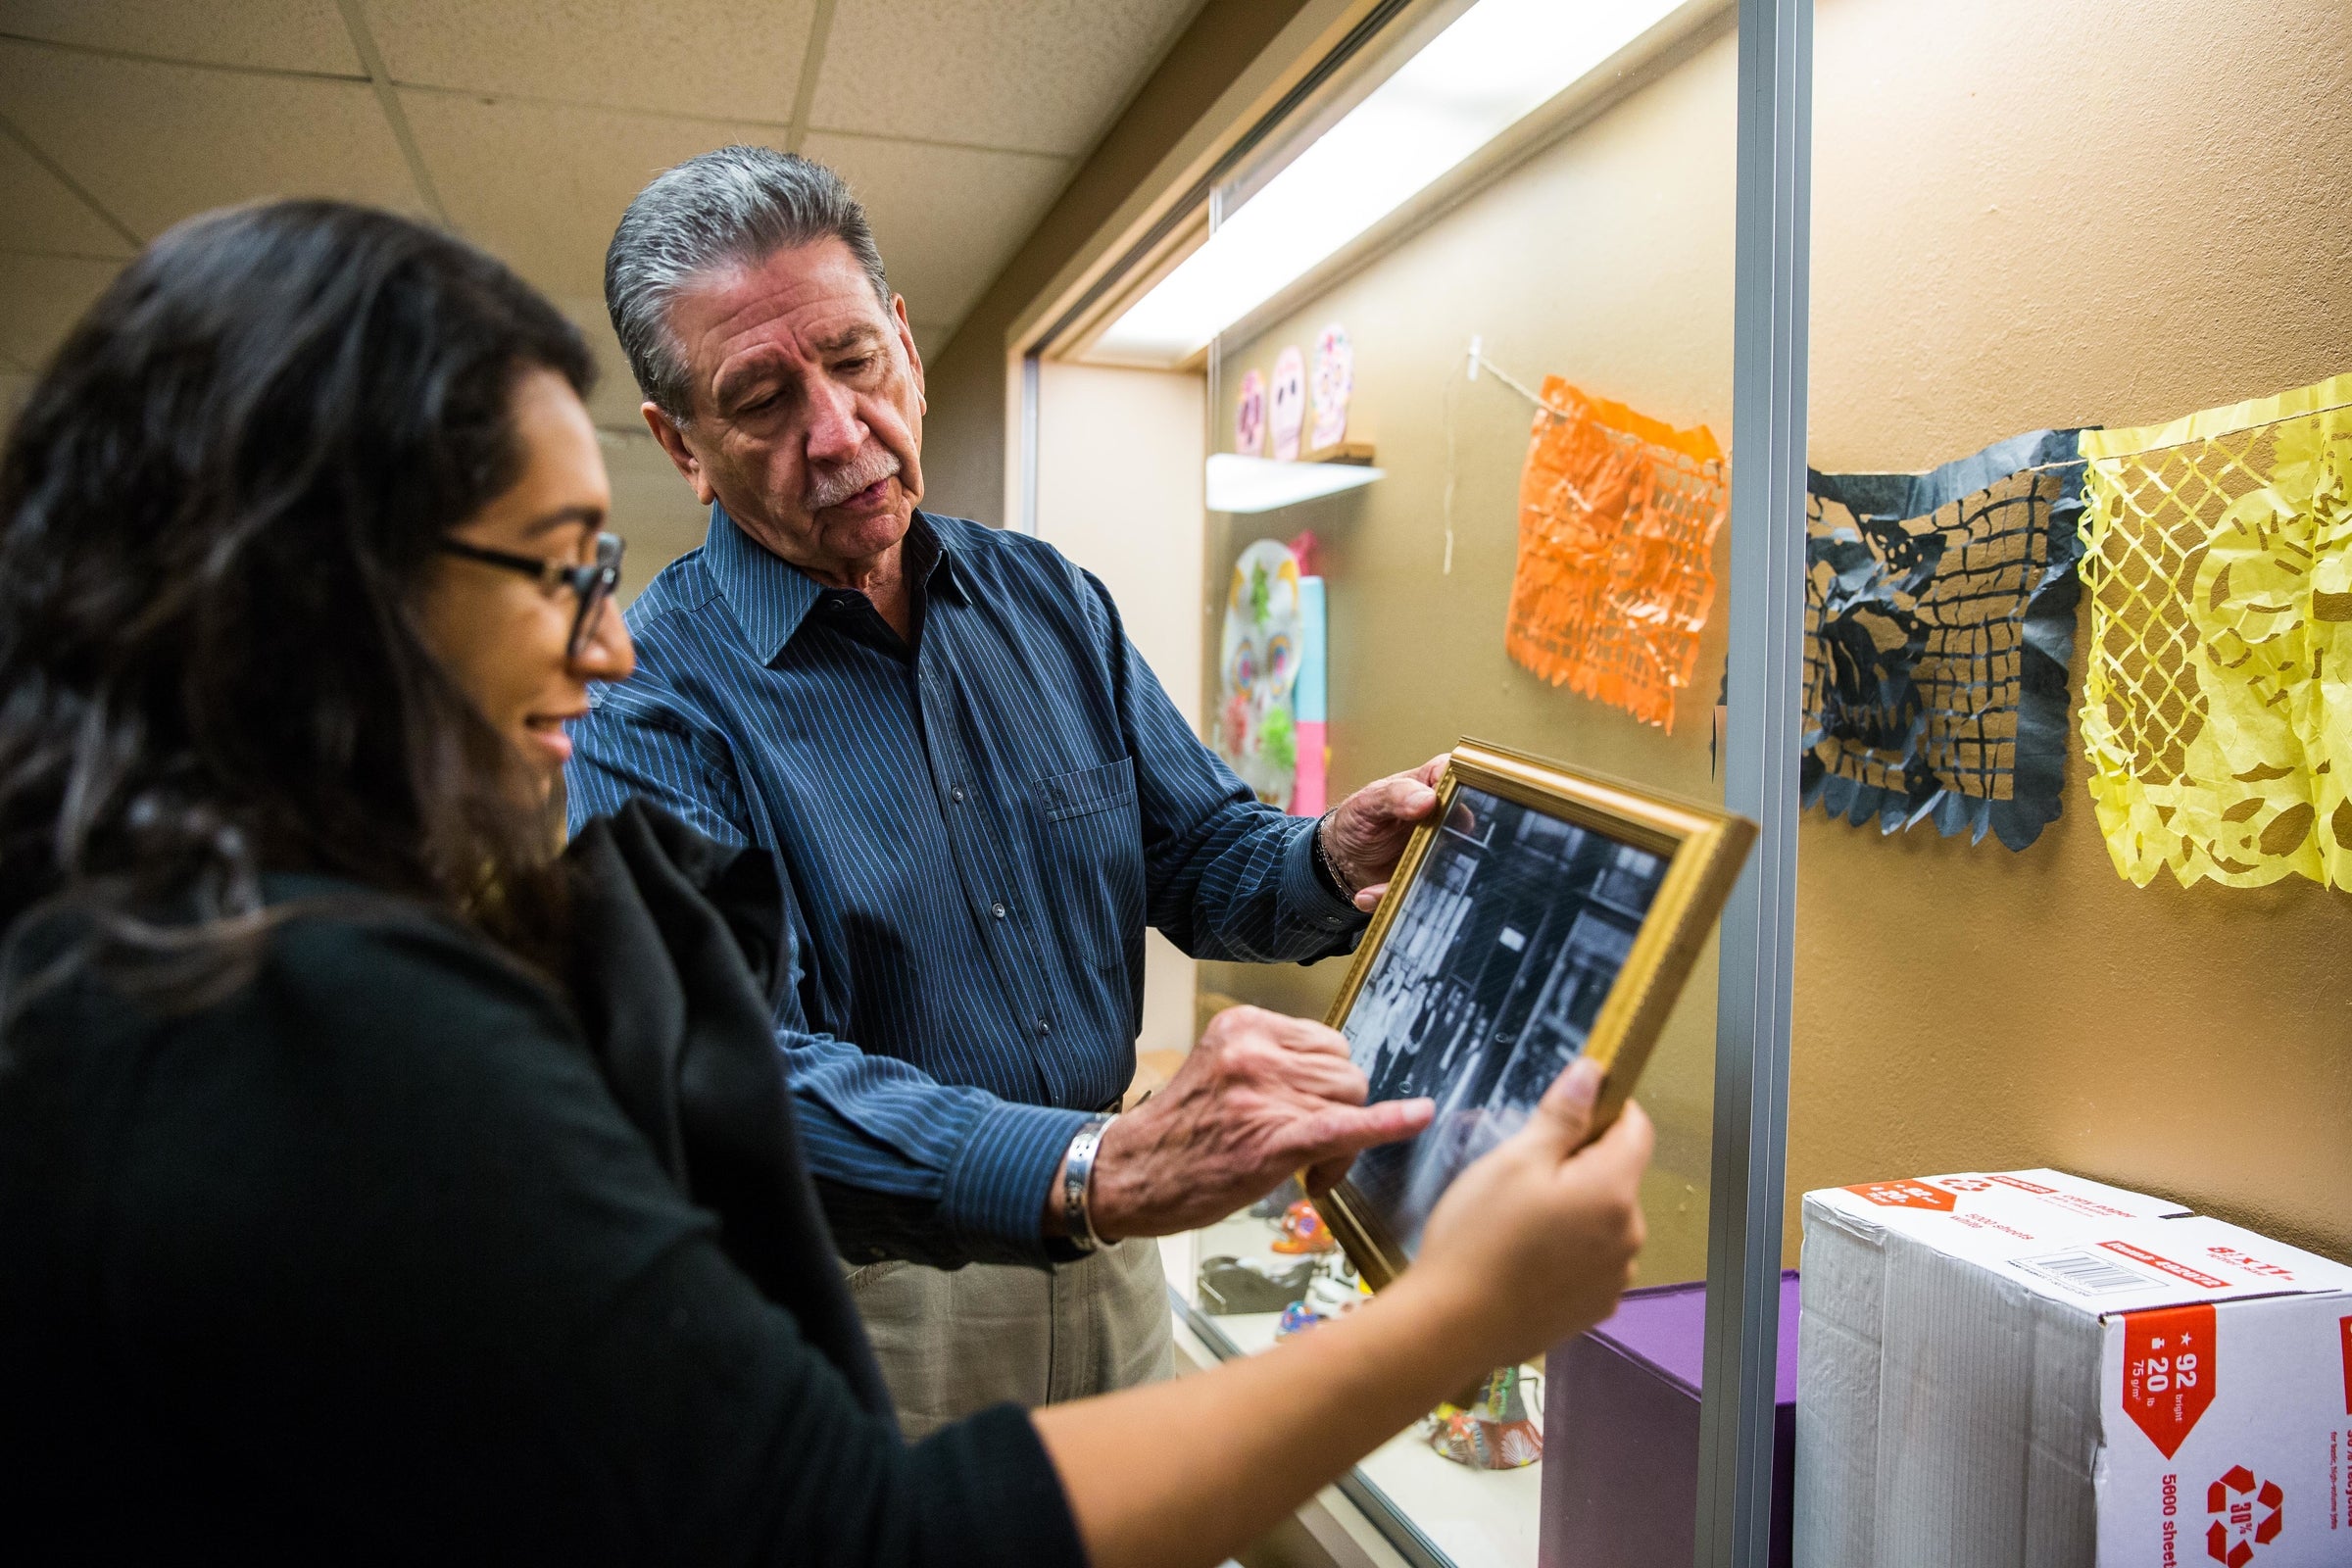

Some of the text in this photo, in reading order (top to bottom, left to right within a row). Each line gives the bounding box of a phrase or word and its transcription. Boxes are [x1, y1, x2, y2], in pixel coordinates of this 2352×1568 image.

[2132, 1359, 2144, 1376] 75
[2147, 1356, 2169, 1406] 20 lb
[2174, 1352, 2197, 1422] 92 bright
[2162, 1474, 2177, 1516] 5000
[2230, 1502, 2253, 1535] 30%
